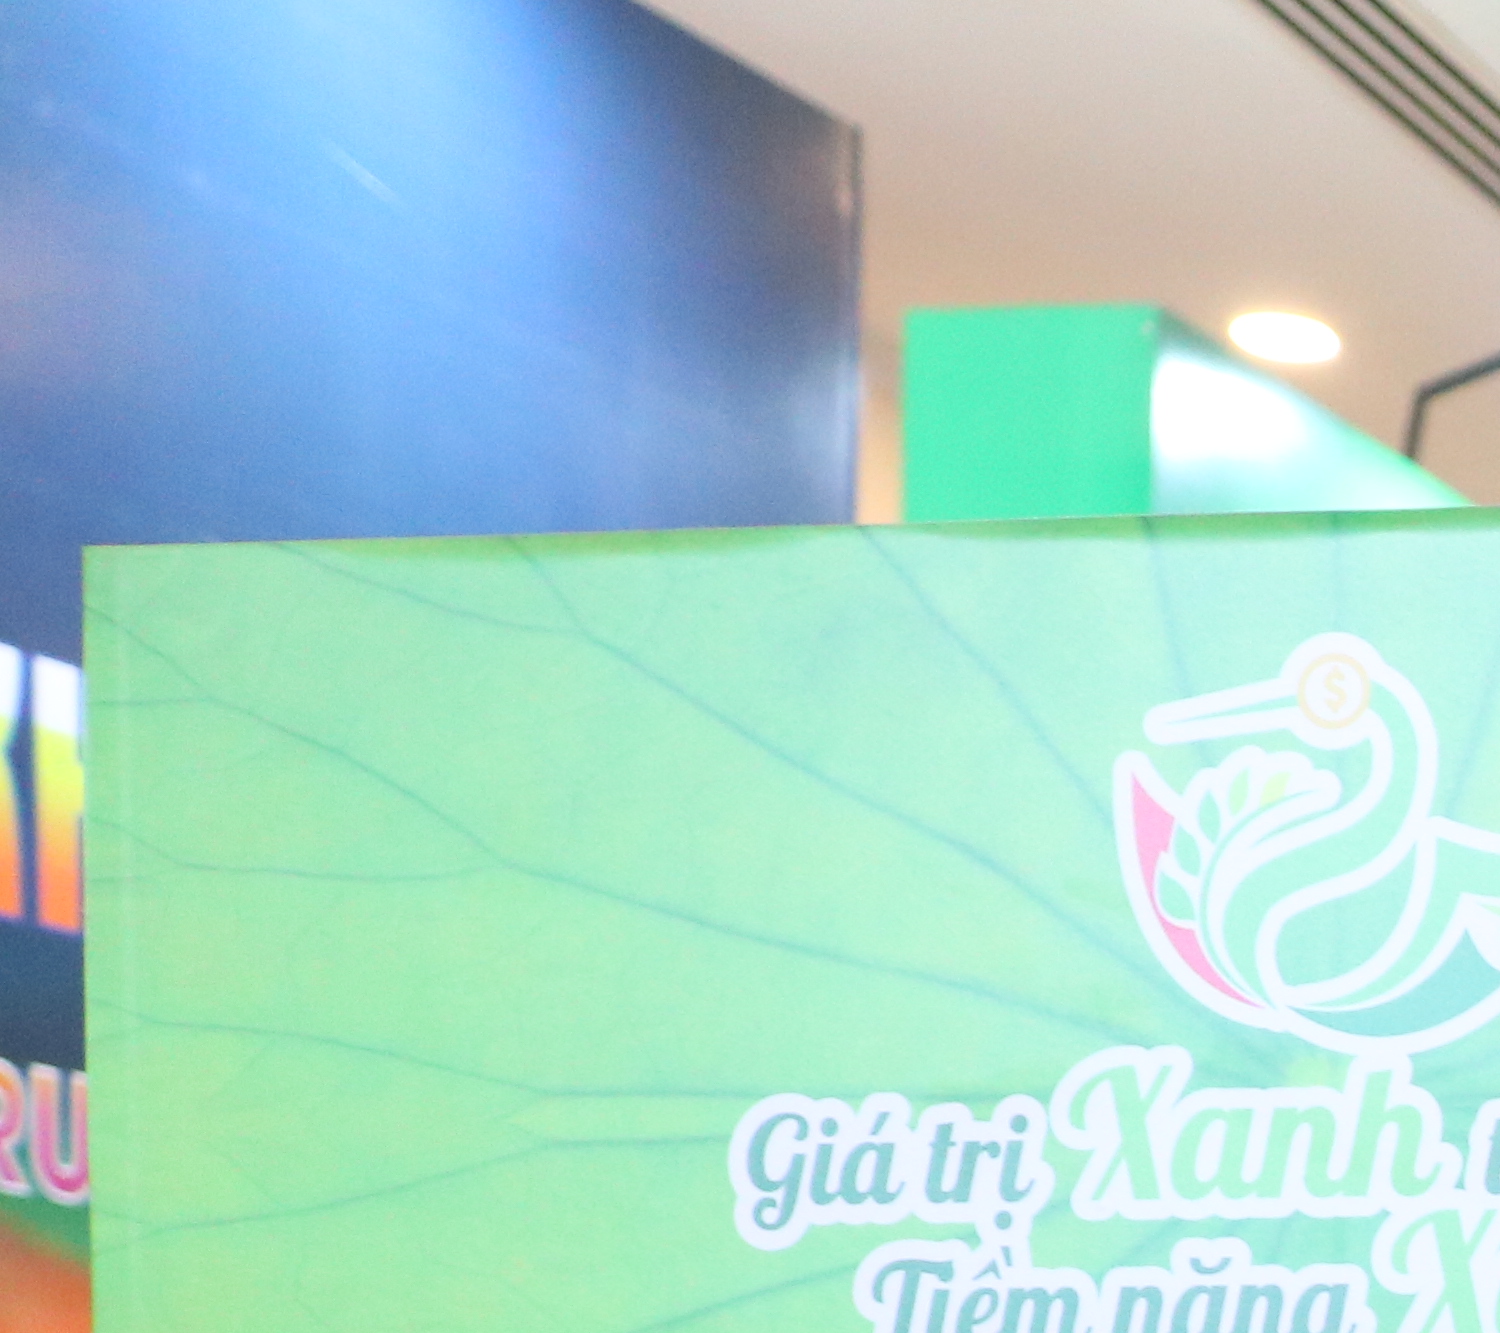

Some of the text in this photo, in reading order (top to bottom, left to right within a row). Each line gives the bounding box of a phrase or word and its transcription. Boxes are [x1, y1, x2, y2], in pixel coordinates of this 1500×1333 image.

[745, 1110, 906, 1232] Giá
[922, 1113, 1036, 1232] trị
[1068, 1063, 1446, 1202] Xanh
